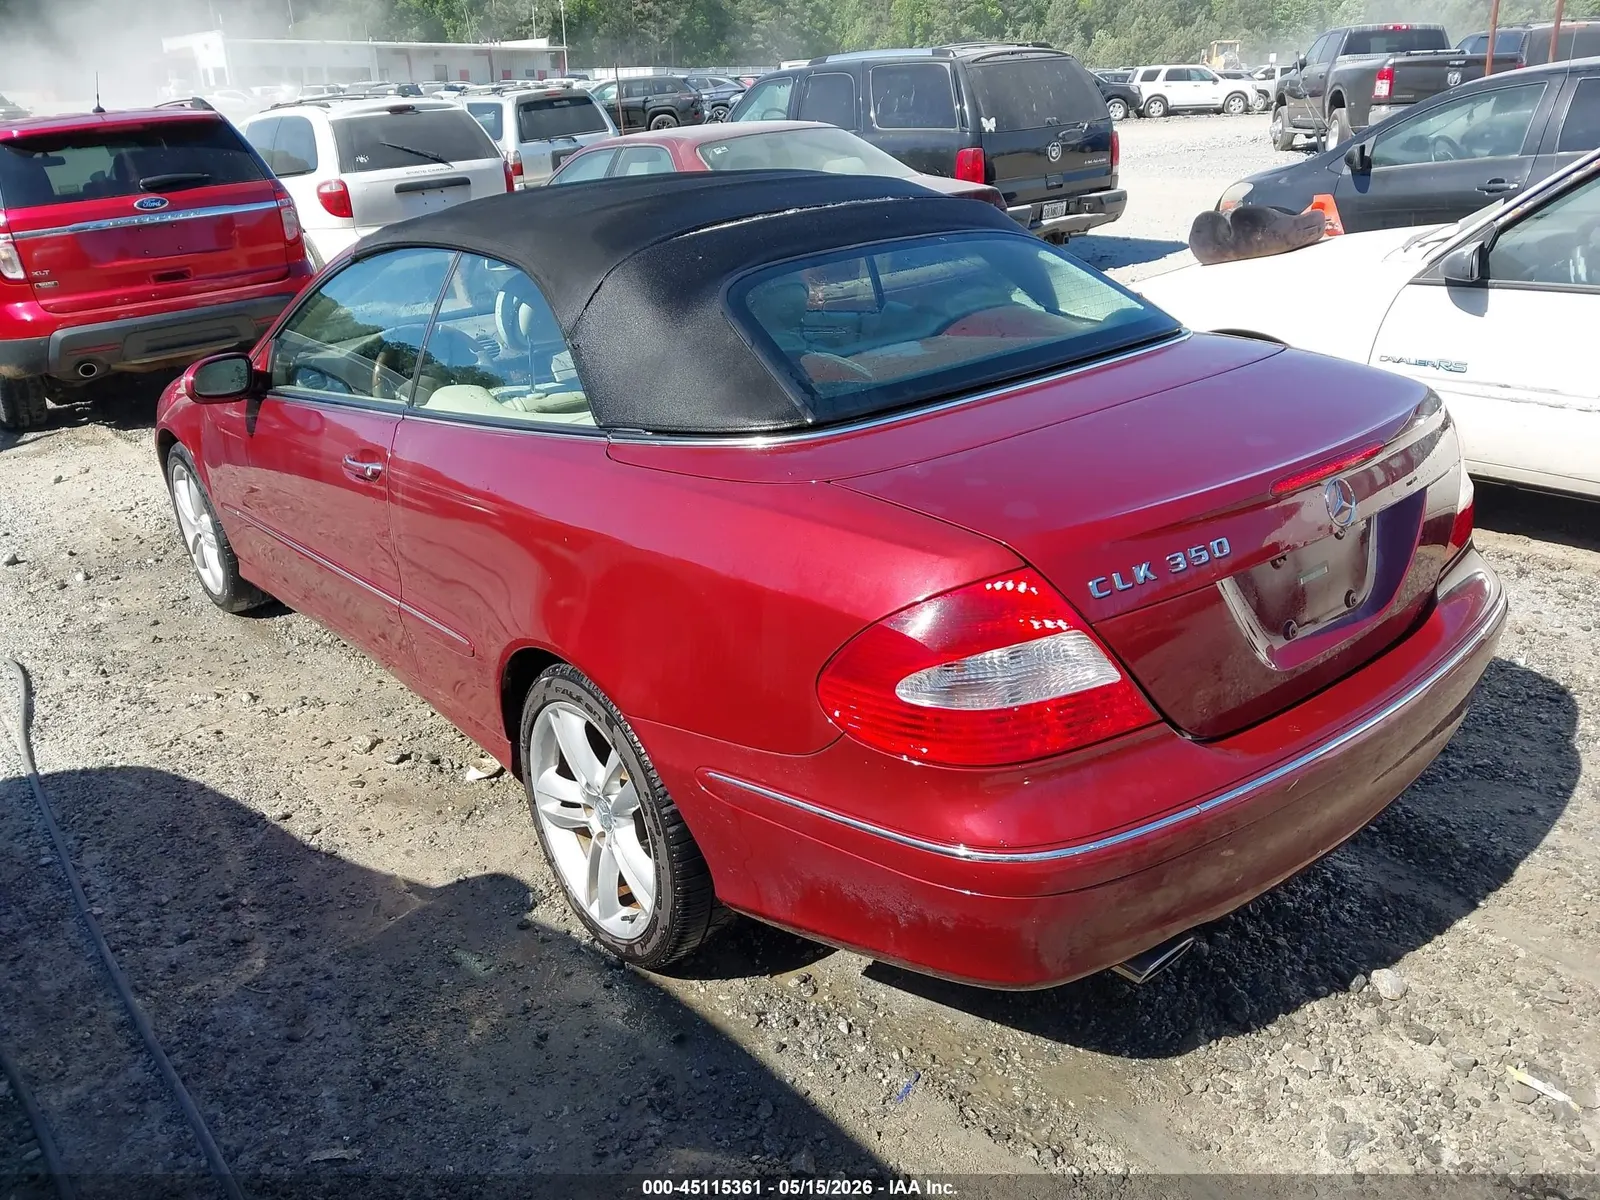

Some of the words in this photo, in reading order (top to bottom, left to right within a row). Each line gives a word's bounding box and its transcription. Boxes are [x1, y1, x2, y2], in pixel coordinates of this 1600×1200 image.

[142, 199, 161, 208] Ford
[1379, 355, 1436, 368] CAVALIER
[1435, 359, 1468, 373] RS
[1088, 561, 1158, 599] CLK
[1165, 537, 1231, 573] 350
